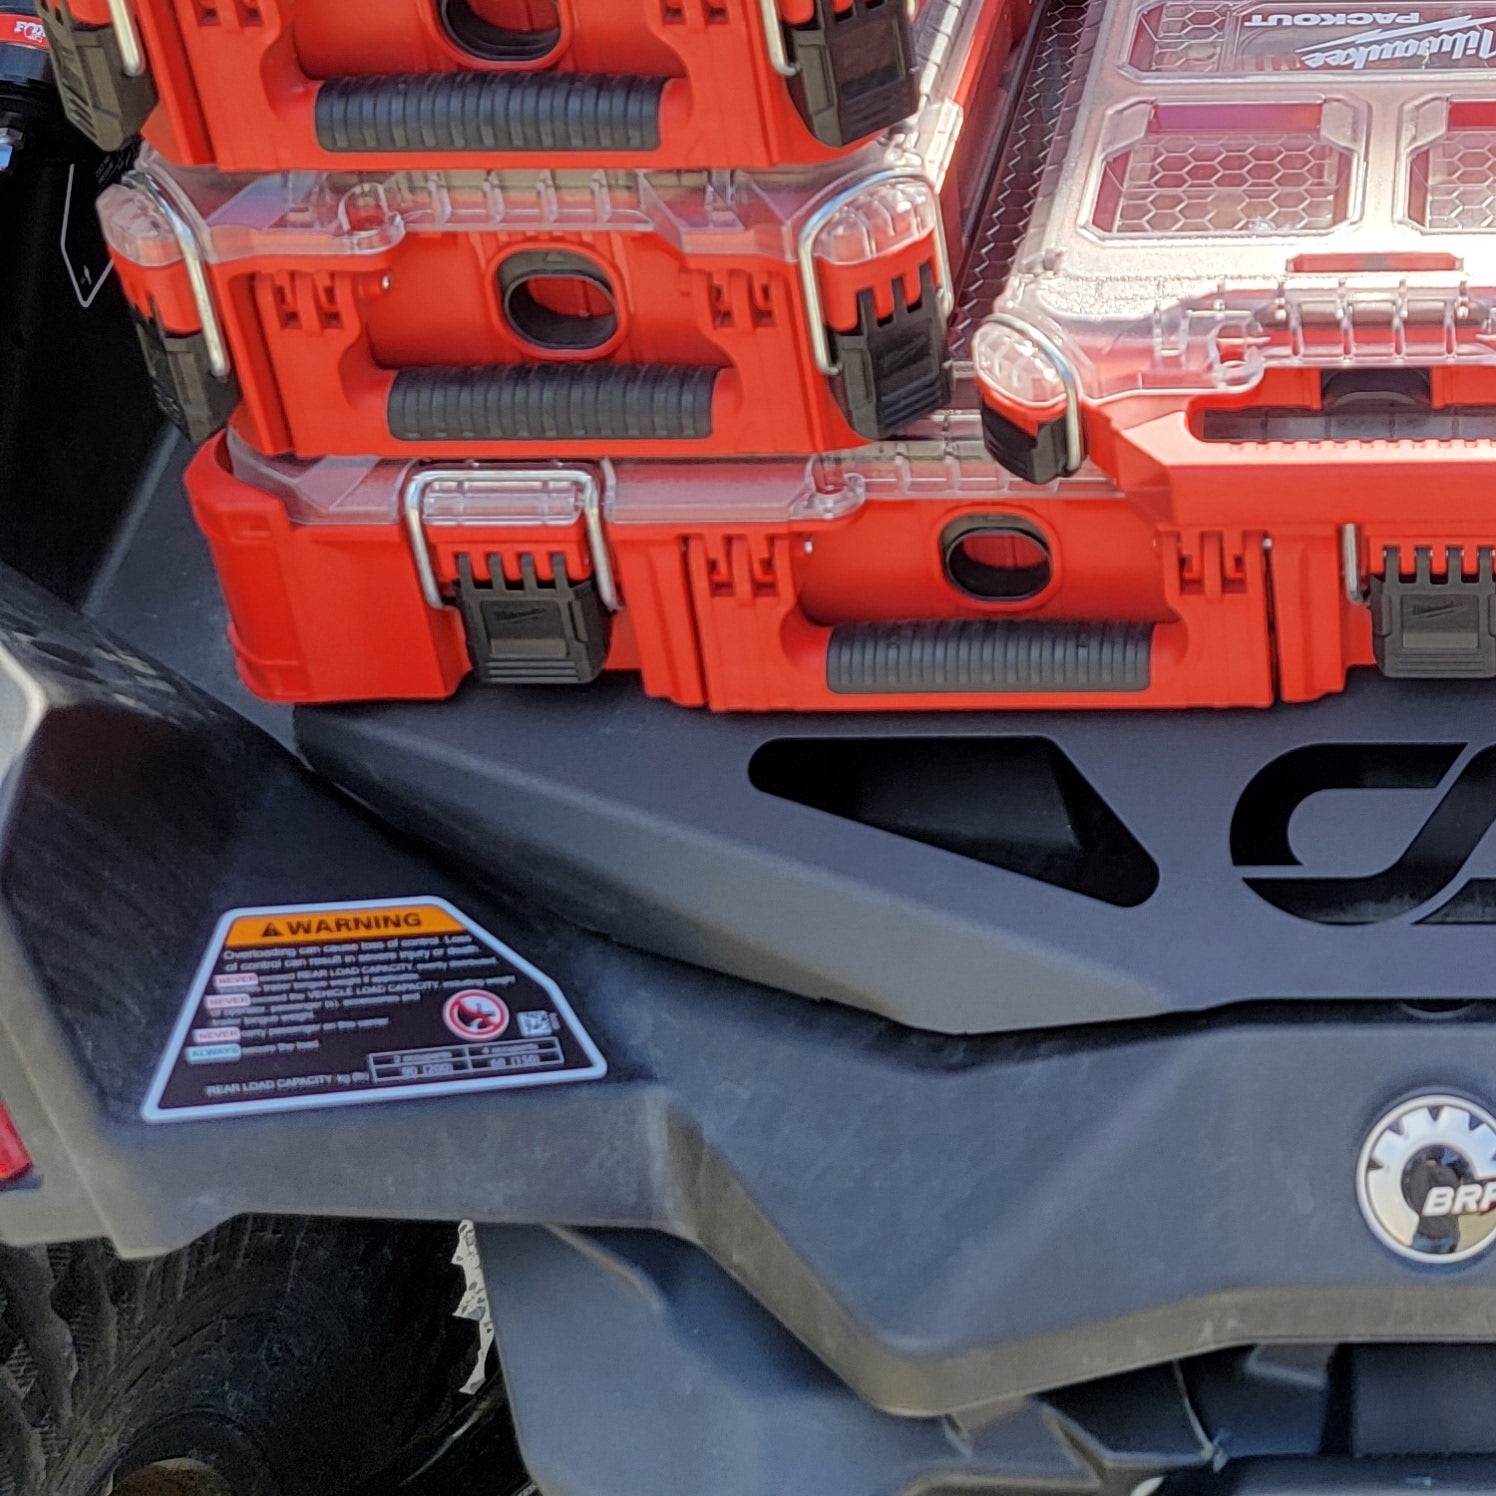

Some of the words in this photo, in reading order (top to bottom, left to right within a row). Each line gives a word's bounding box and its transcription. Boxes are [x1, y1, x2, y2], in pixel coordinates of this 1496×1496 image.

[1245, 12, 1423, 28] PACKOUT
[286, 912, 422, 936] WARNING
[224, 948, 297, 960] Overloading
[217, 974, 257, 984] NEVER
[329, 966, 360, 977] LOAD
[209, 995, 249, 1005] NEVER
[308, 988, 354, 999] VEHICLE
[356, 984, 386, 995] LOAD
[199, 1029, 240, 1039] NEVER
[191, 1045, 239, 1058] ALWAYS
[207, 1082, 241, 1096] REAR
[242, 1079, 275, 1092] LOAD
[277, 1074, 333, 1089] CAPACITY
